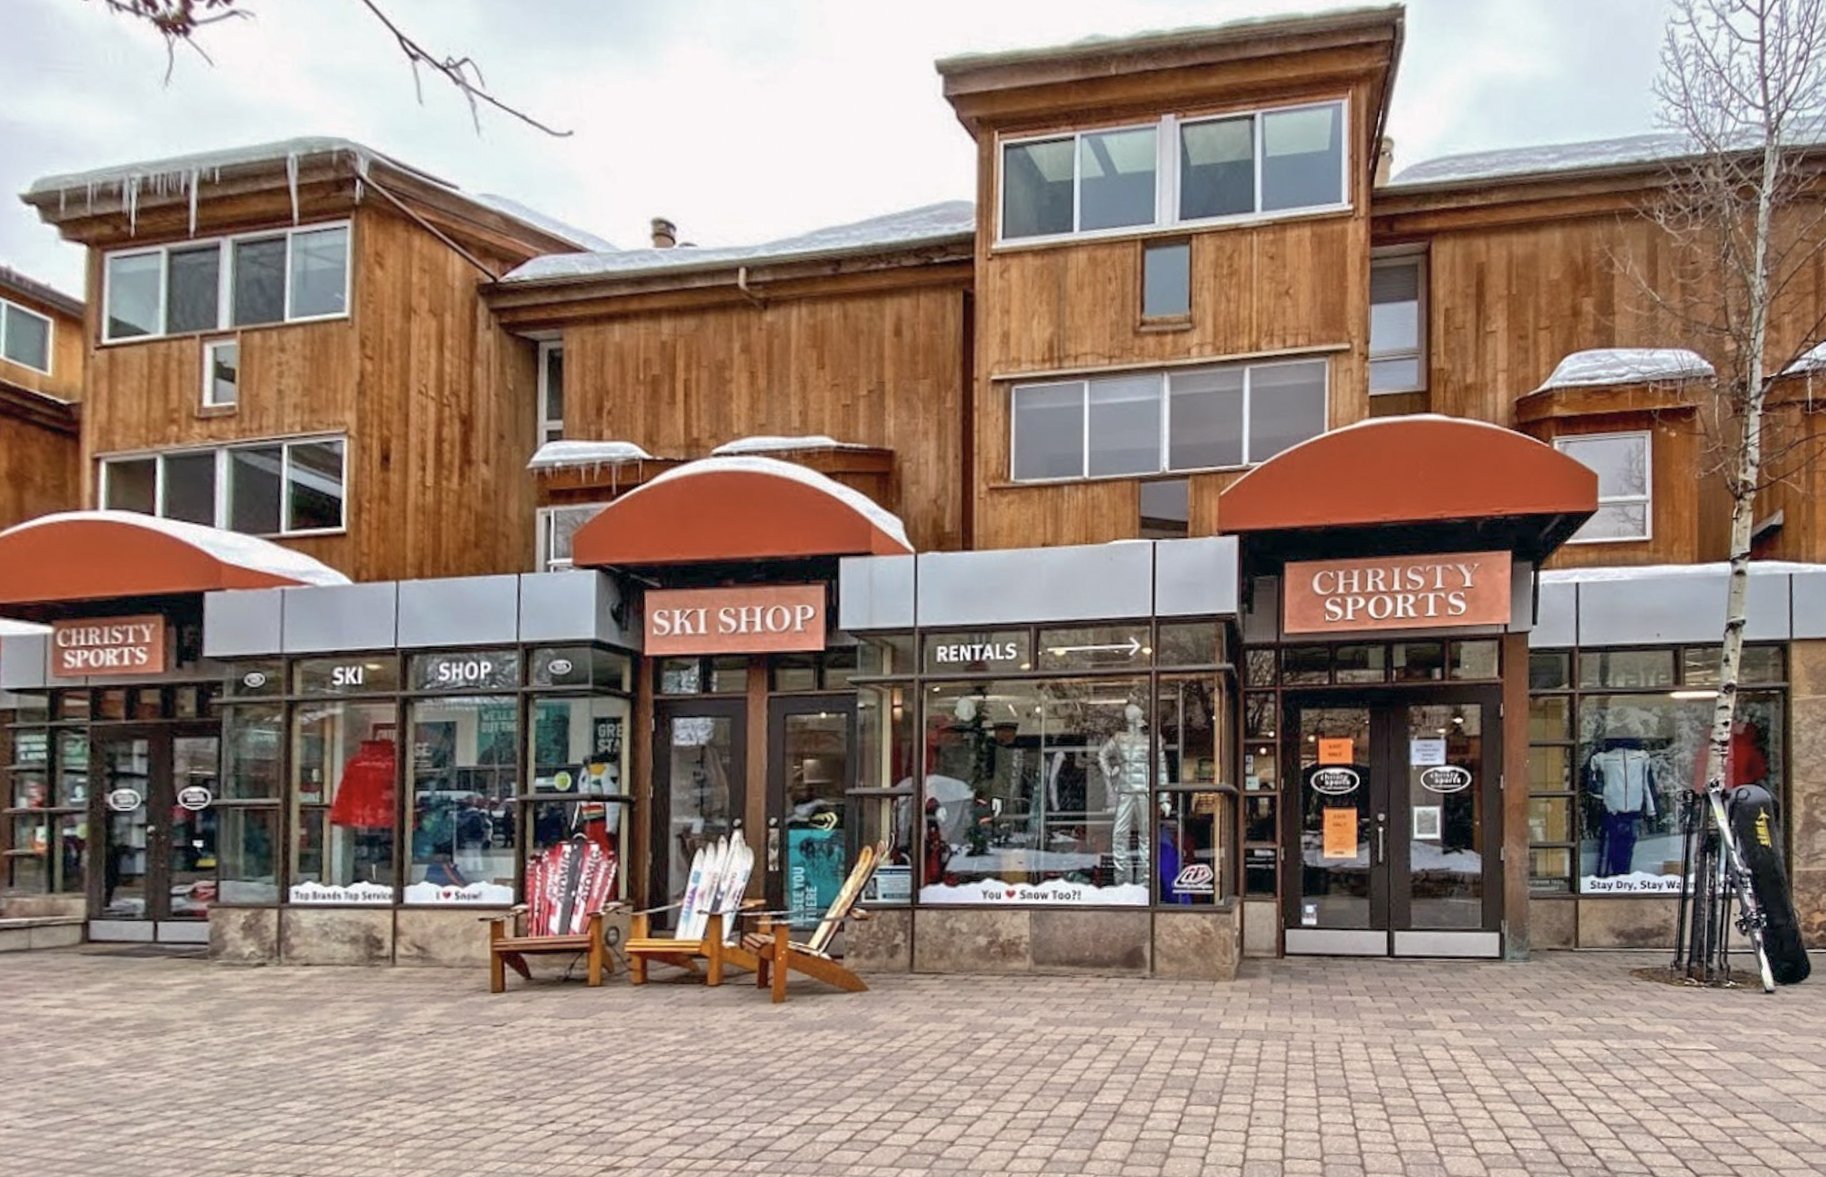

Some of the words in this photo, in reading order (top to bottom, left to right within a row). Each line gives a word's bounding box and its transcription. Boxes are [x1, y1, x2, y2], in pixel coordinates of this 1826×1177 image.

[1312, 562, 1479, 596] CHRISTY
[1324, 591, 1467, 622] SPORTS
[652, 608, 707, 637] SKI
[717, 603, 816, 635] SHOP
[56, 623, 155, 647] CHRISTY
[62, 645, 149, 670] SPORTS
[935, 642, 1018, 663] RENTALS
[332, 665, 363, 686] SKI
[437, 661, 492, 681] SHOP
[792, 866, 805, 889] YOU
[1590, 880, 1613, 892] Stay
[1616, 880, 1637, 892] Dry,
[1640, 880, 1663, 892] Stay
[294, 890, 310, 902] Top
[312, 890, 342, 900] Brands
[344, 890, 359, 902] Top
[361, 890, 393, 900] Service
[453, 890, 482, 901] Snow!
[981, 889, 1002, 900] You
[1019, 889, 1048, 900] Snow
[1051, 889, 1082, 900] Too?!
